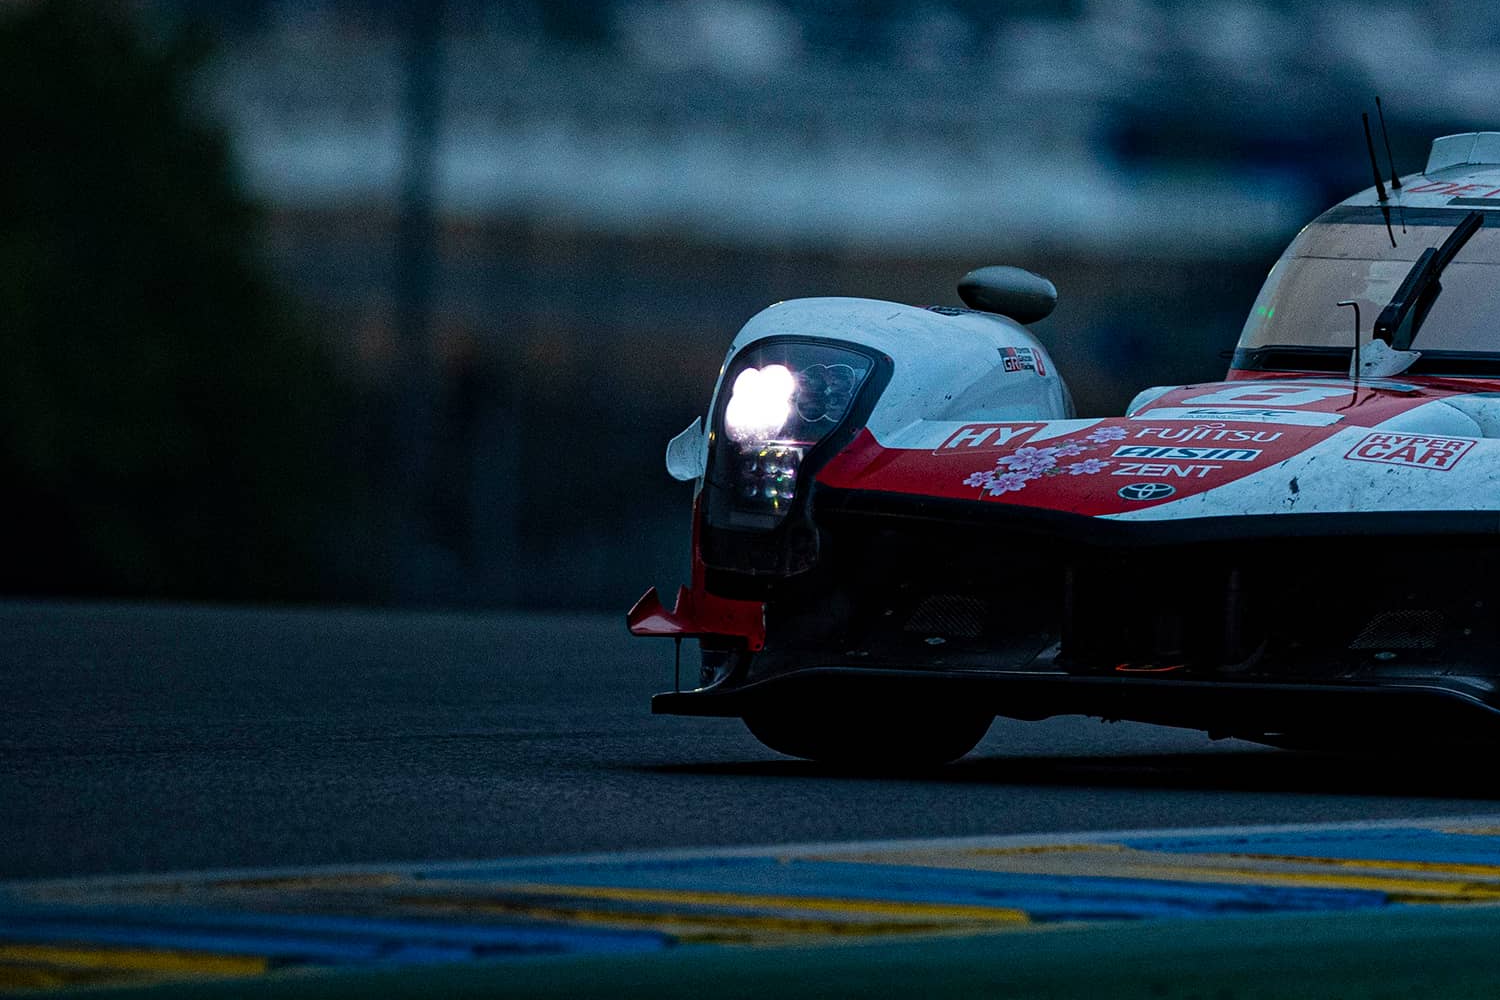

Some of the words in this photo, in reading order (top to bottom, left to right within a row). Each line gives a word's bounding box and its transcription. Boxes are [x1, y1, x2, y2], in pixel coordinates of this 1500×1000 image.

[944, 426, 1038, 449] HY
[1133, 425, 1285, 443] FUJITSU
[1369, 435, 1466, 451] HYPER
[1114, 446, 1258, 460] AISIN
[1357, 443, 1454, 467] CAR
[1111, 462, 1224, 478] ZENT
